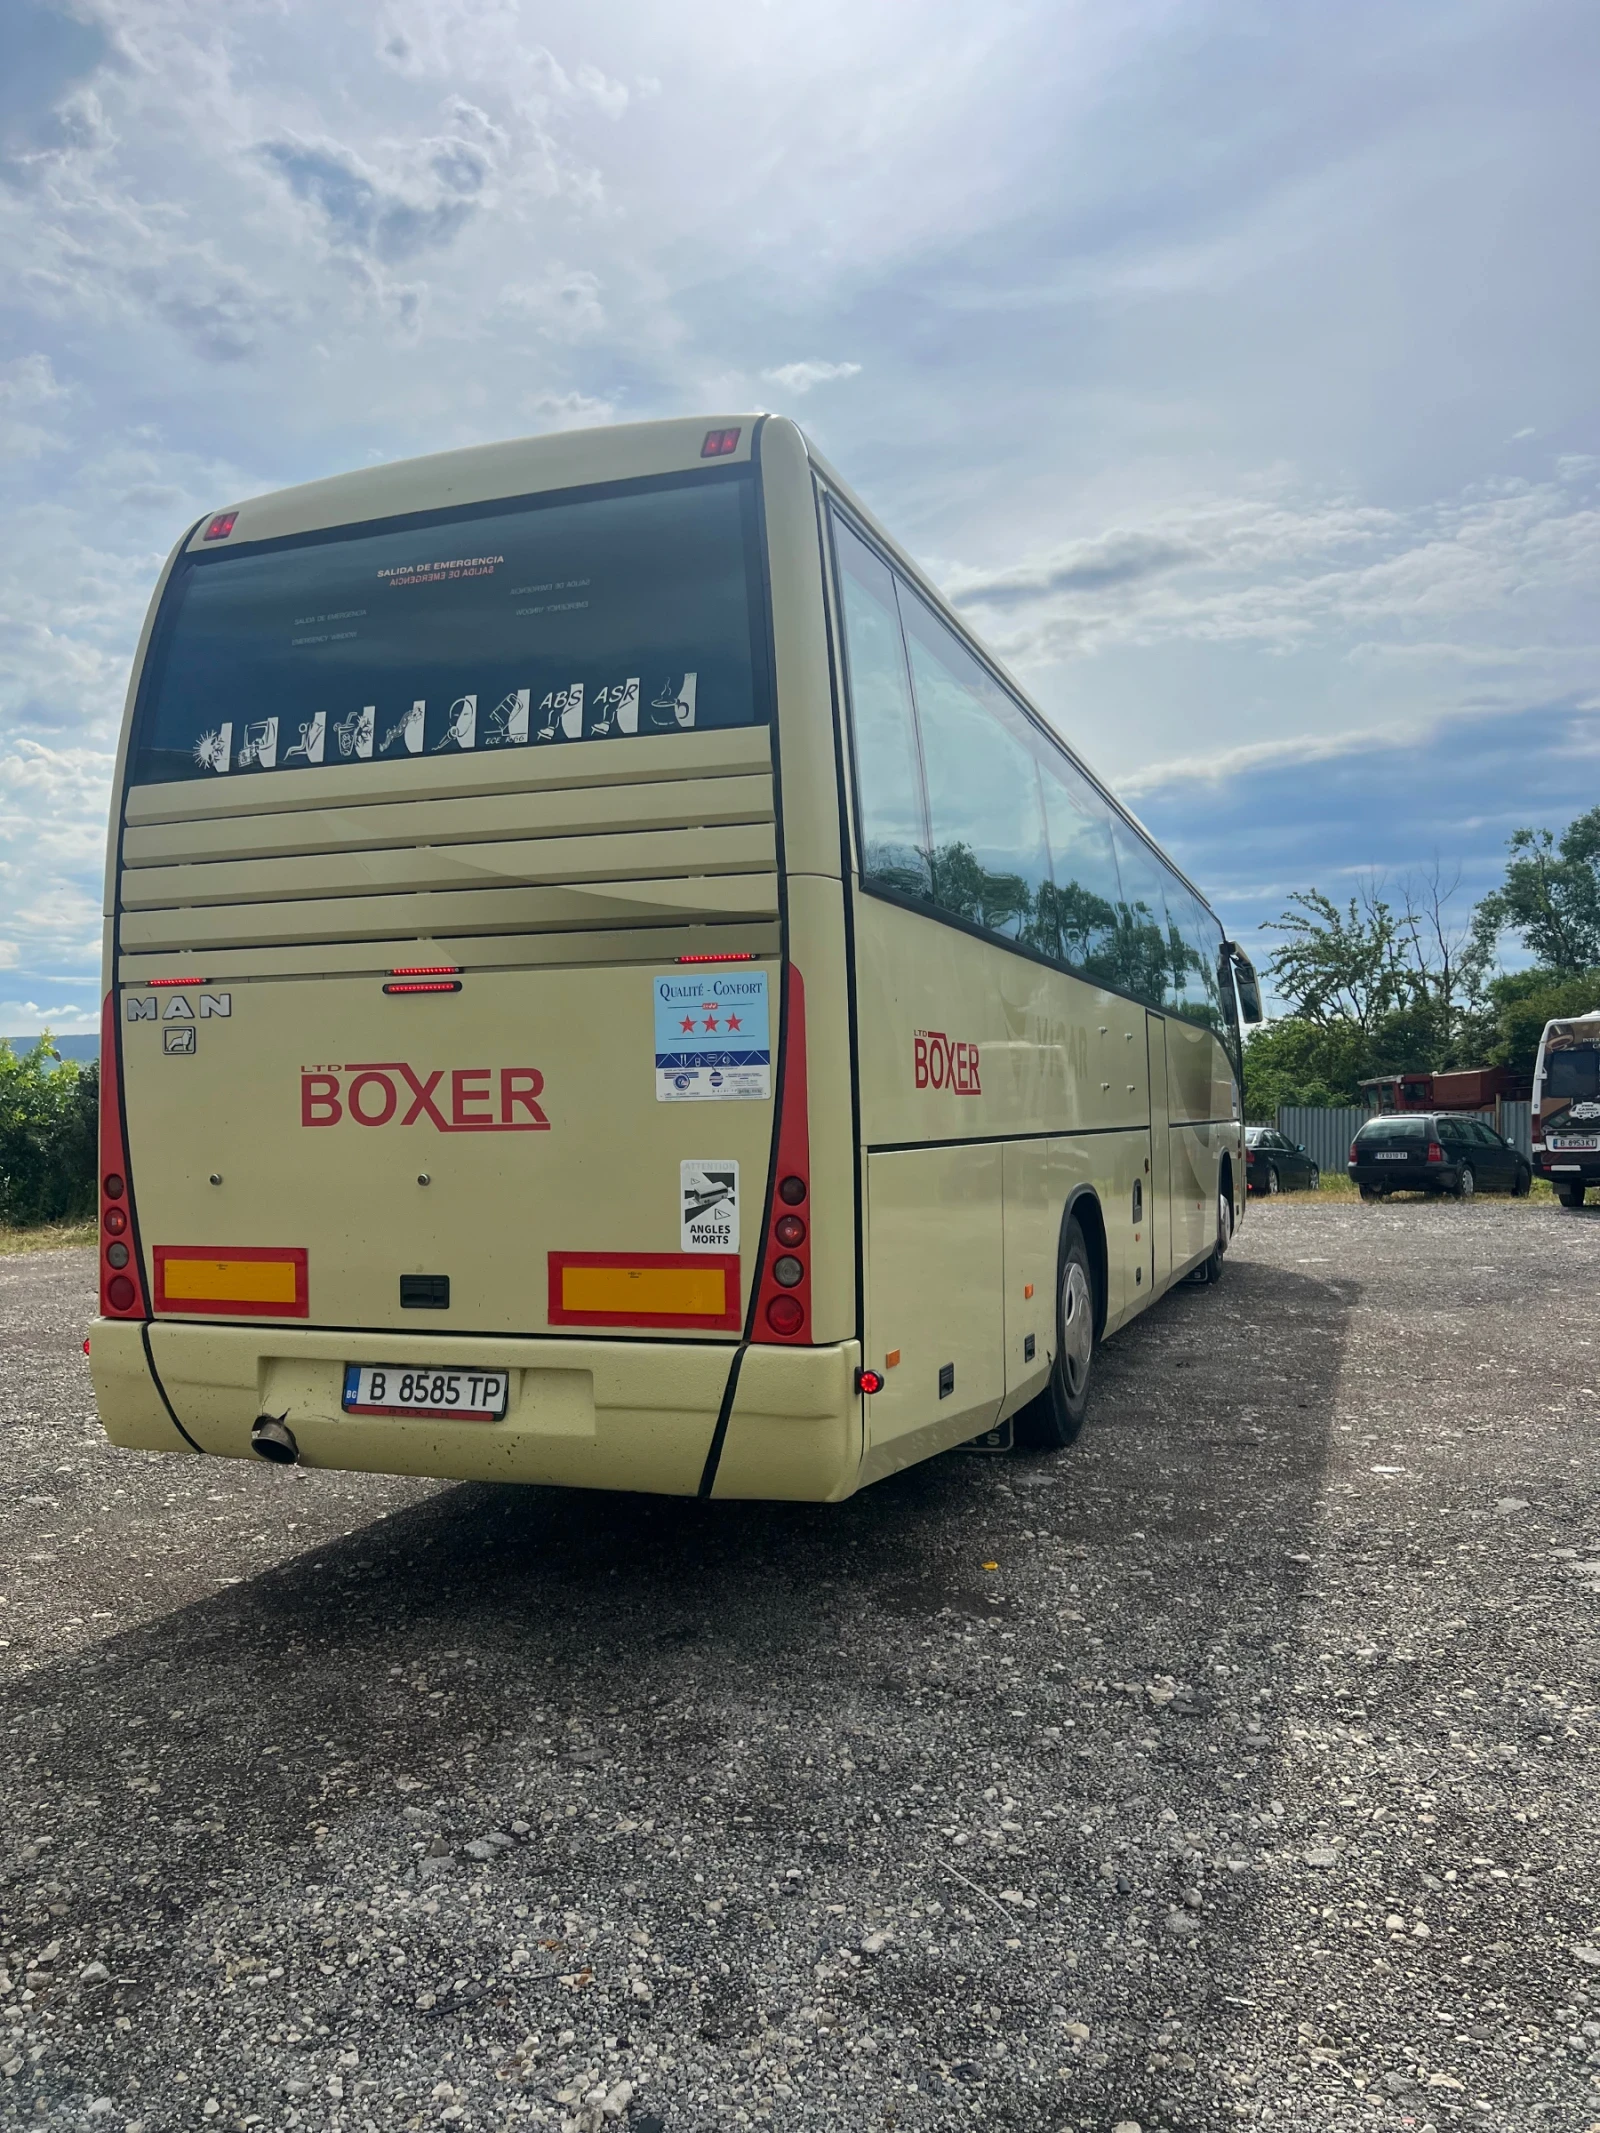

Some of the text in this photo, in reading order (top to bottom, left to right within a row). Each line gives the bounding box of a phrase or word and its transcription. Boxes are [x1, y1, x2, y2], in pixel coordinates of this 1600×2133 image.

[377, 556, 504, 578] SALIDA DE EMERGENCIA
[539, 689, 583, 710] ABS
[593, 684, 638, 705] ASR
[660, 982, 704, 1002] QUALITÉ
[713, 980, 763, 996] CONFORT
[127, 993, 231, 1021] MAN
[914, 1029, 927, 1037] LTD
[301, 1064, 342, 1073] LTD
[914, 1031, 981, 1095] BOXER
[301, 1063, 551, 1132] BOXER
[685, 1162, 735, 1170] ATTENTION
[690, 1224, 731, 1234] ANGLES
[692, 1234, 729, 1244] MORTS
[346, 1372, 500, 1407] BG B 8585 TP
[388, 1408, 450, 1418] BOXER
